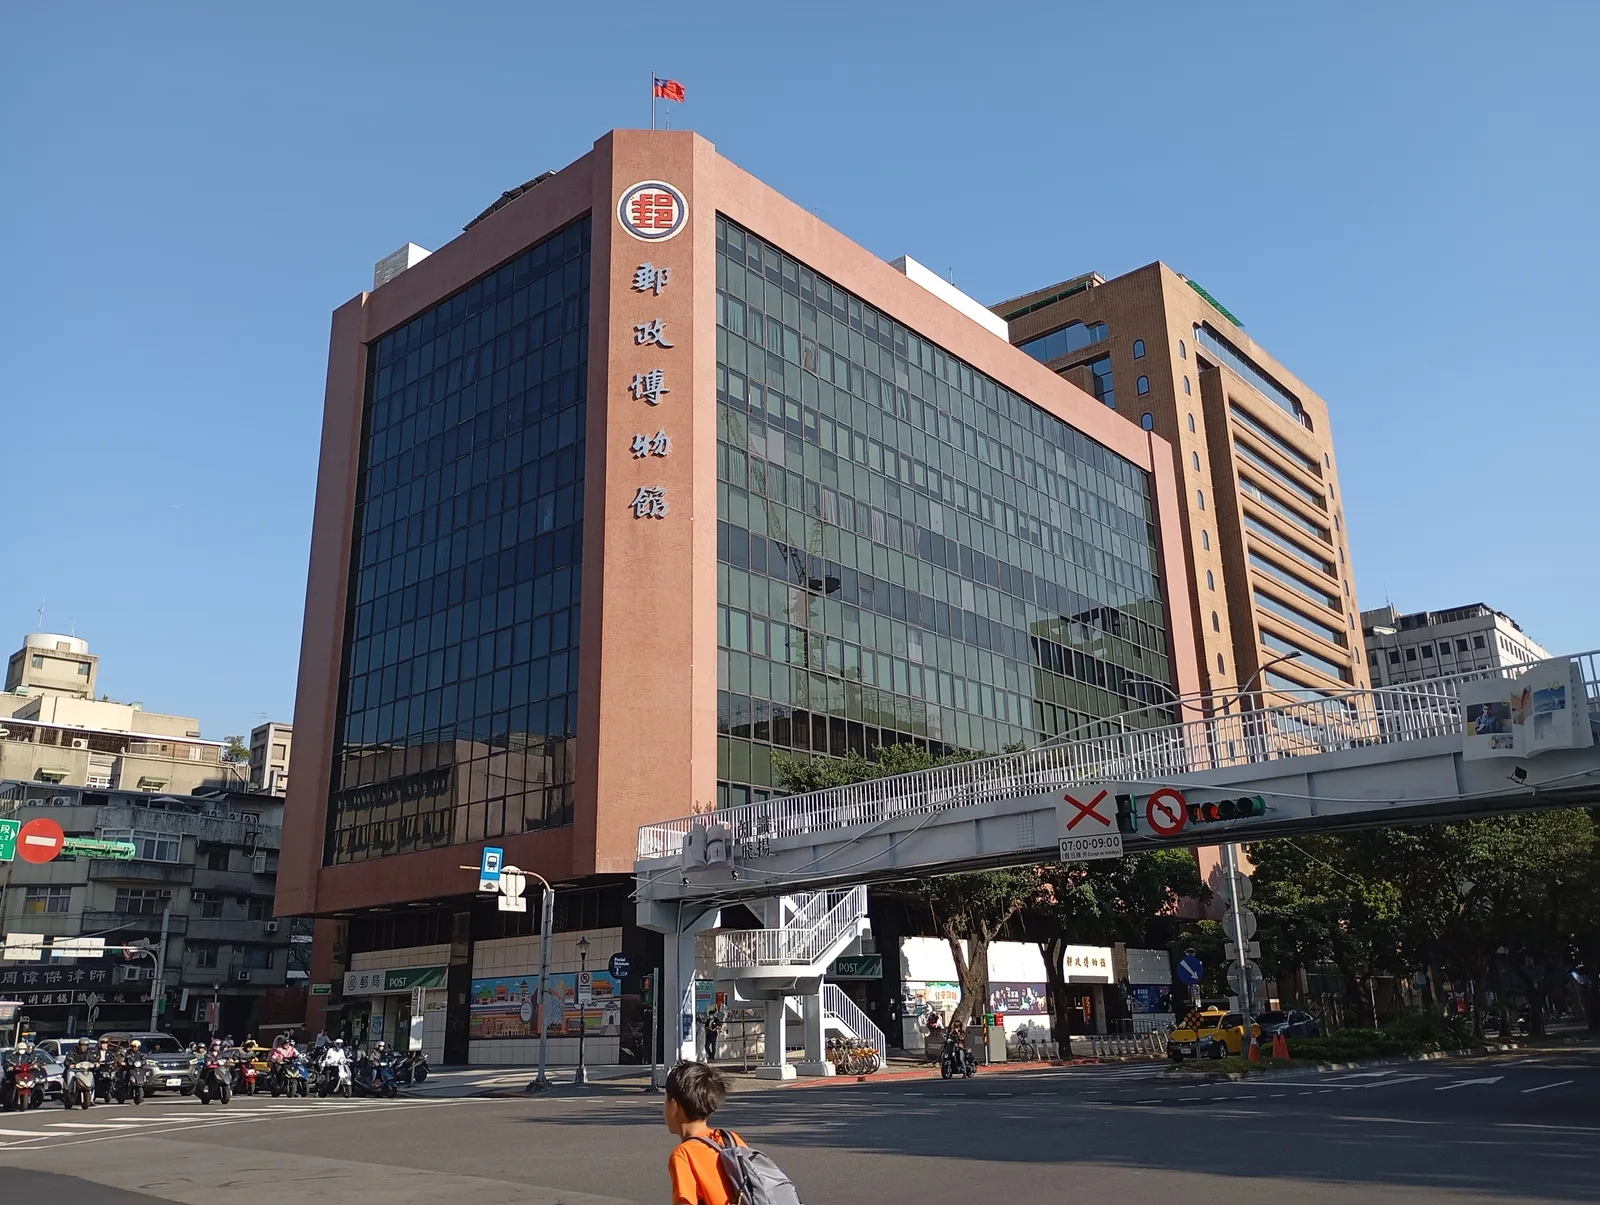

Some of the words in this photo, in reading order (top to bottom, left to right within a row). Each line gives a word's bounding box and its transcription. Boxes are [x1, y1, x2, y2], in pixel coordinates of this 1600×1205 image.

[629, 261, 675, 520] 郵政博物館
[1061, 836, 1120, 851] 07:00-09:00
[838, 962, 858, 973] POST
[1, 968, 107, 985] 周偉傑律師
[389, 976, 408, 988] POST
